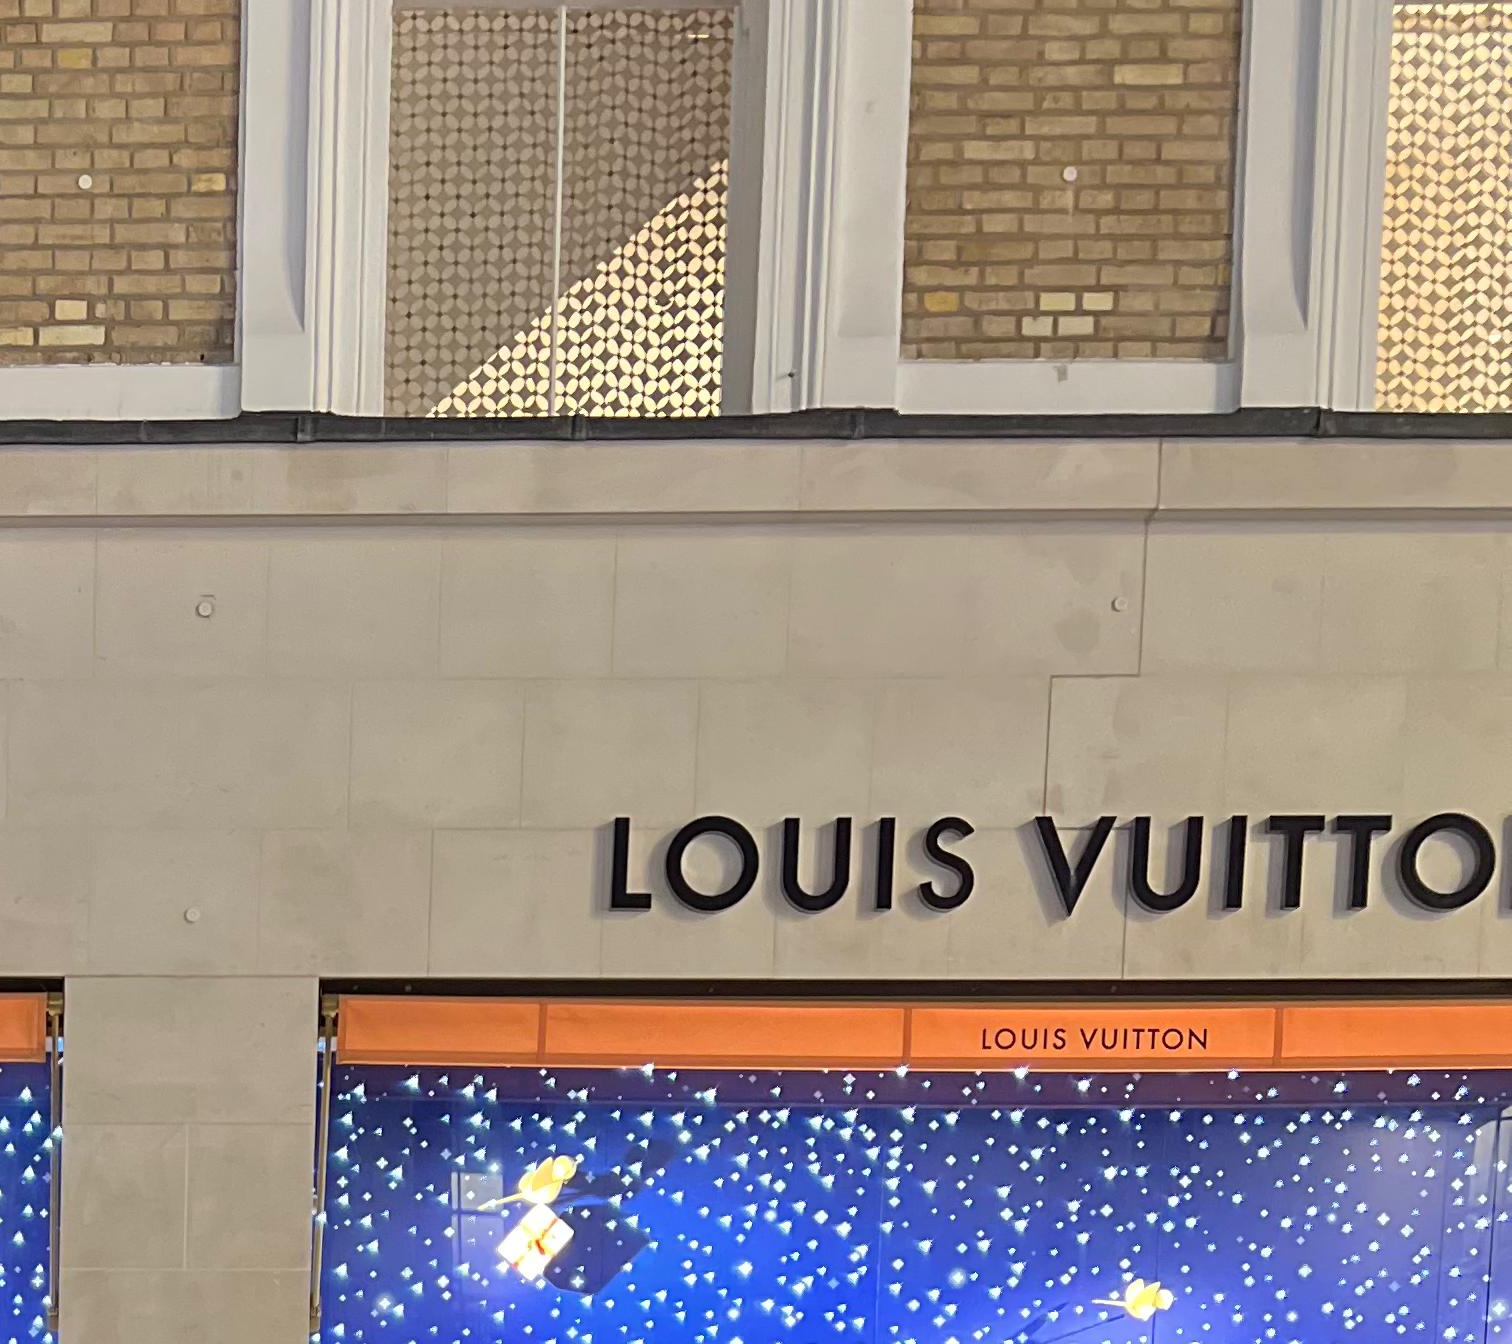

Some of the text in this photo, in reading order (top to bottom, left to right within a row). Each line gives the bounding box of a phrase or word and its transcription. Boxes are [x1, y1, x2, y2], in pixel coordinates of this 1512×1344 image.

[607, 812, 1512, 916] LOUIS VUITTO
[981, 1028, 1207, 1049] LOUIS VUITTON
